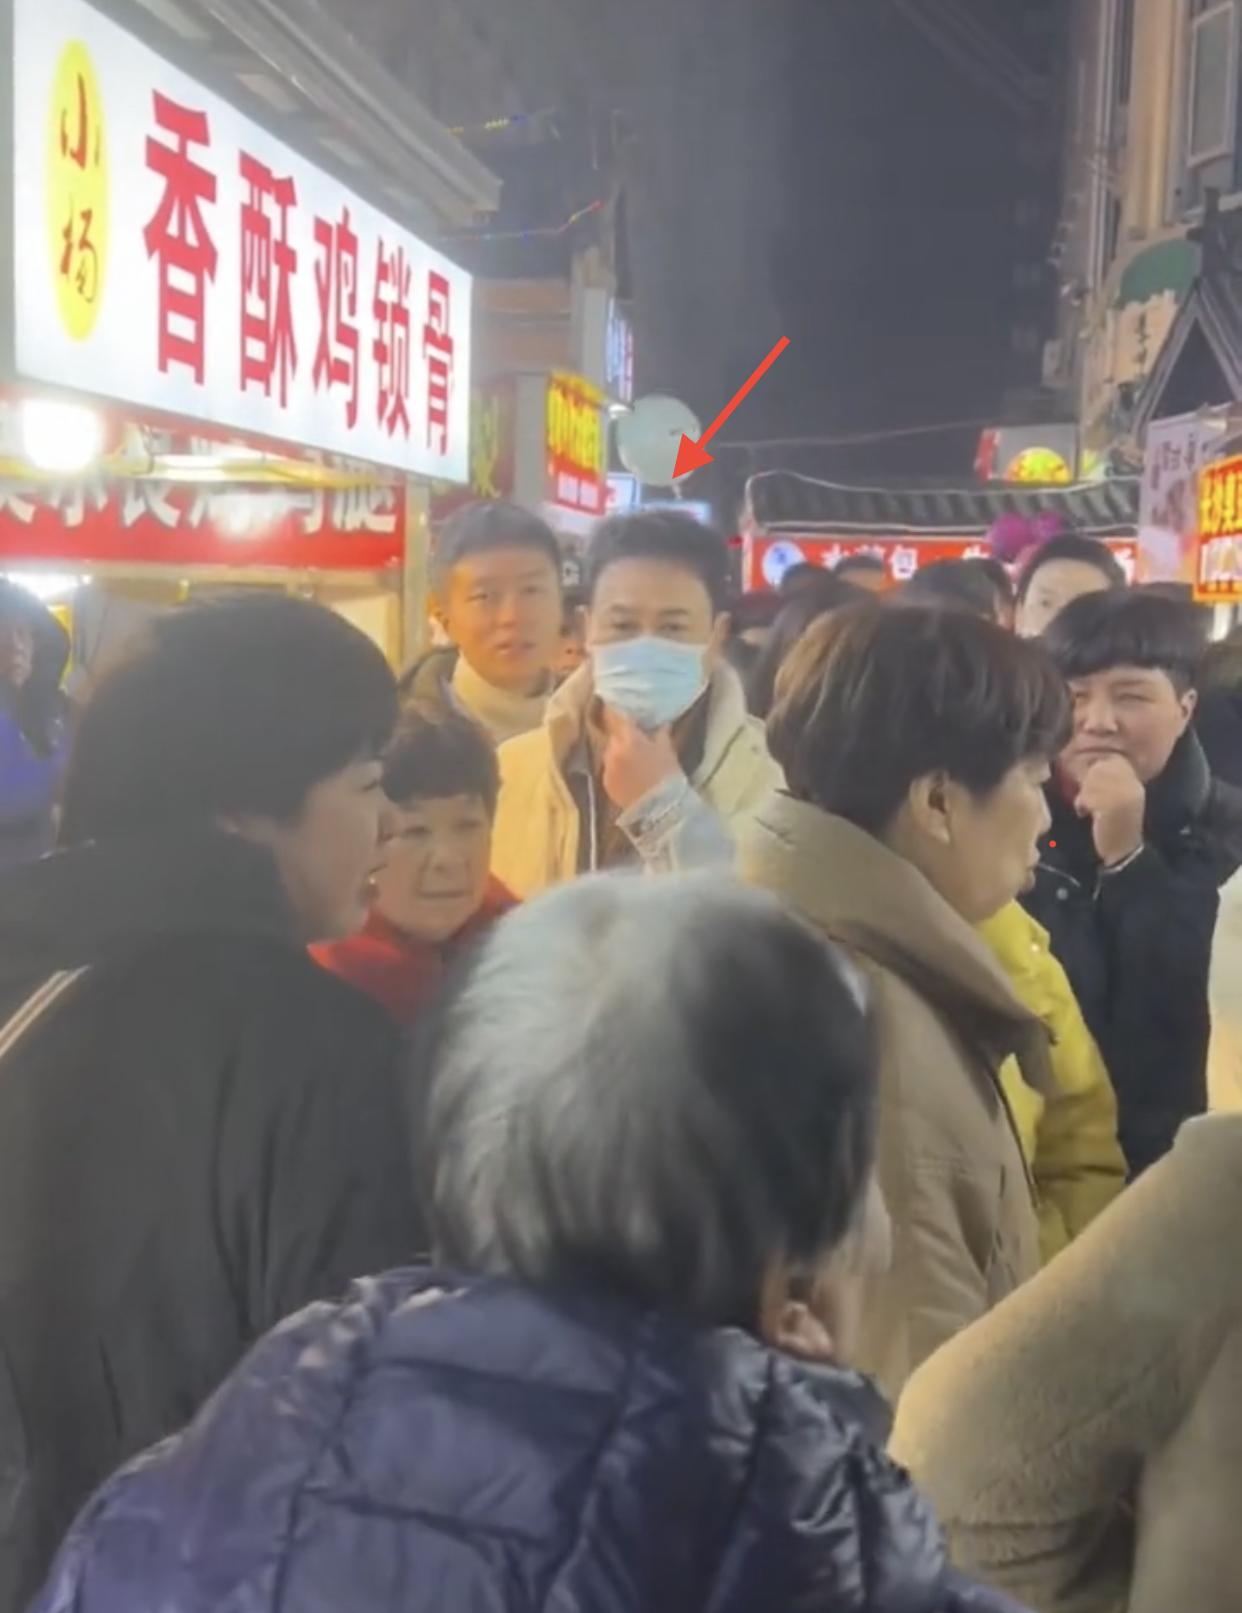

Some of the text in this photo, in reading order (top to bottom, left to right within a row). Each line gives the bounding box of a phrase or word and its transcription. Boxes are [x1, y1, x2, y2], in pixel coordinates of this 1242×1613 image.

[143, 89, 454, 455] 香酥鸡锁骨
